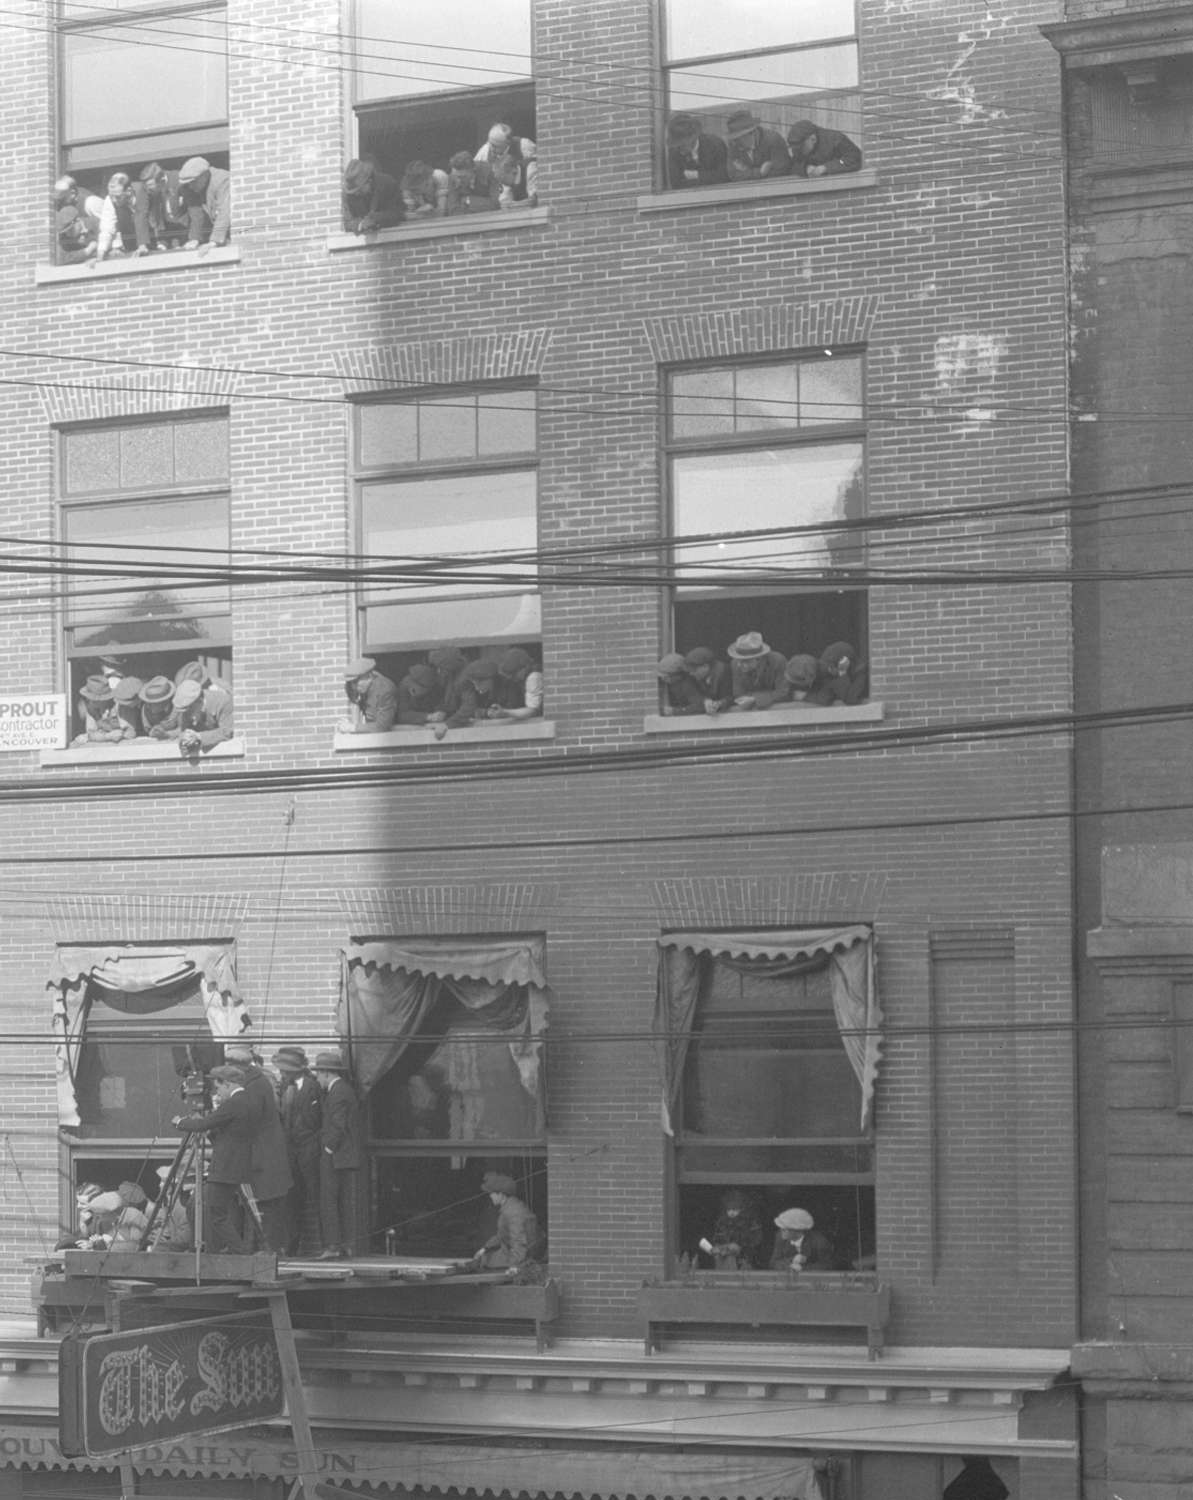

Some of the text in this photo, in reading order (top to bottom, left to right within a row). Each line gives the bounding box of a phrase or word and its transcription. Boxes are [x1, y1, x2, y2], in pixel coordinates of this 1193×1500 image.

[98, 1331, 280, 1435] The Sun
[138, 1446, 257, 1467] DAILY
